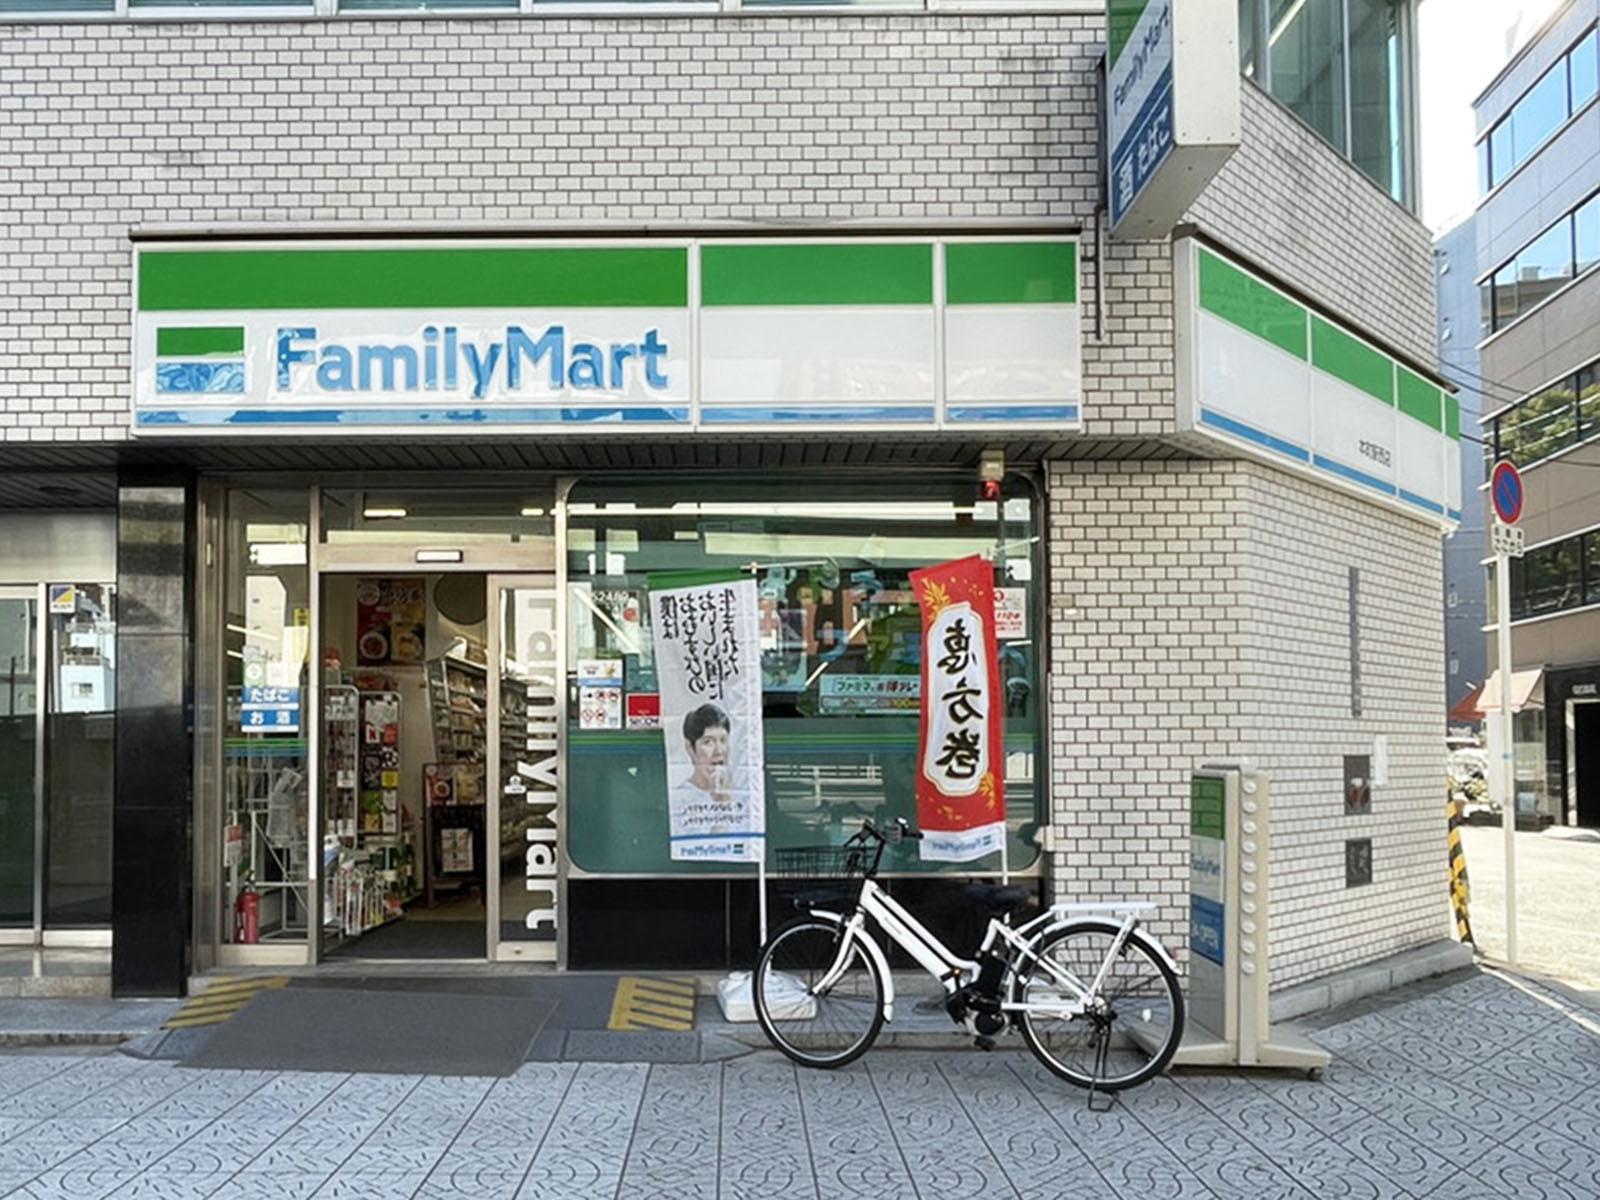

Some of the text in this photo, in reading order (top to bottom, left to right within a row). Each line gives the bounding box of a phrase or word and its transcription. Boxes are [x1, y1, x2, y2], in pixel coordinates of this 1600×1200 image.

[275, 325, 669, 399] FamilyMart
[249, 689, 291, 703] たばこ
